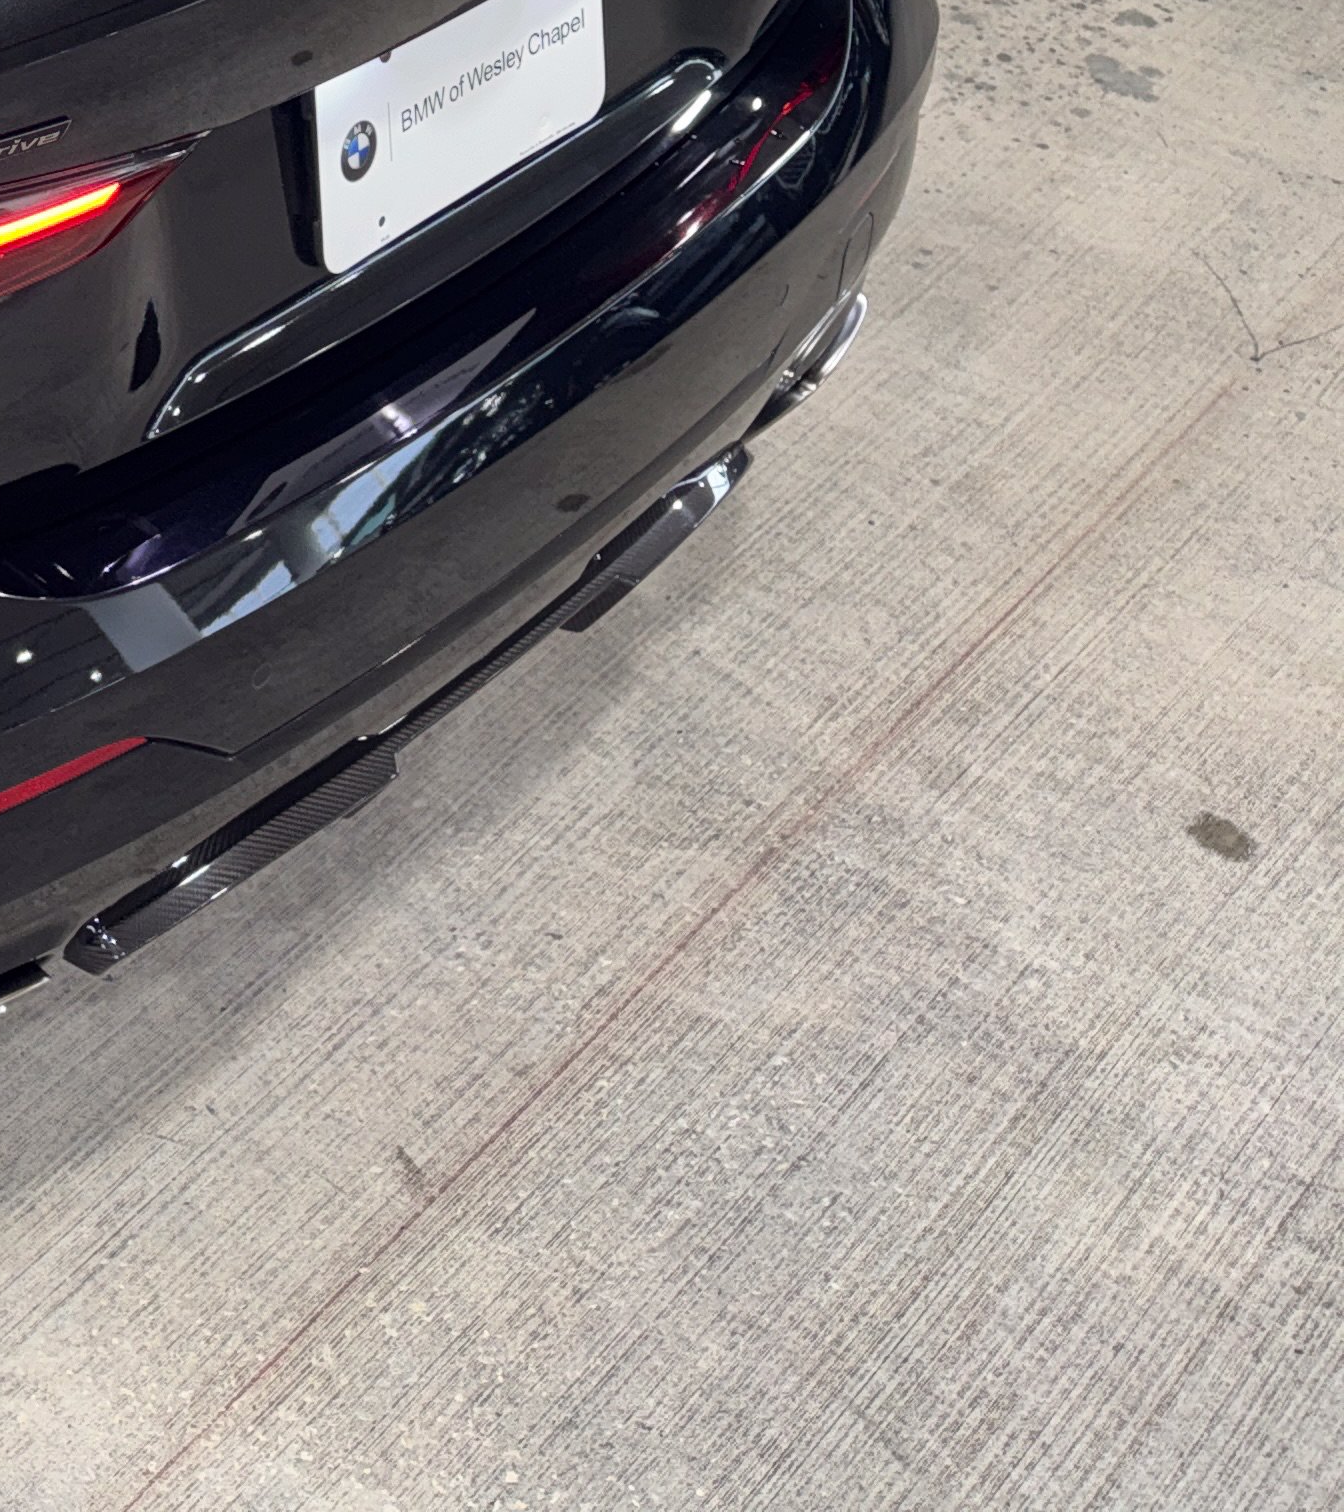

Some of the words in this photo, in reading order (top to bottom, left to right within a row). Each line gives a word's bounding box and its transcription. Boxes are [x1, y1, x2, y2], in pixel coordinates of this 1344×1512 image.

[401, 87, 446, 133] BMW
[449, 74, 466, 102] of
[466, 45, 525, 90] Wesley
[527, 8, 586, 55] Chapel
